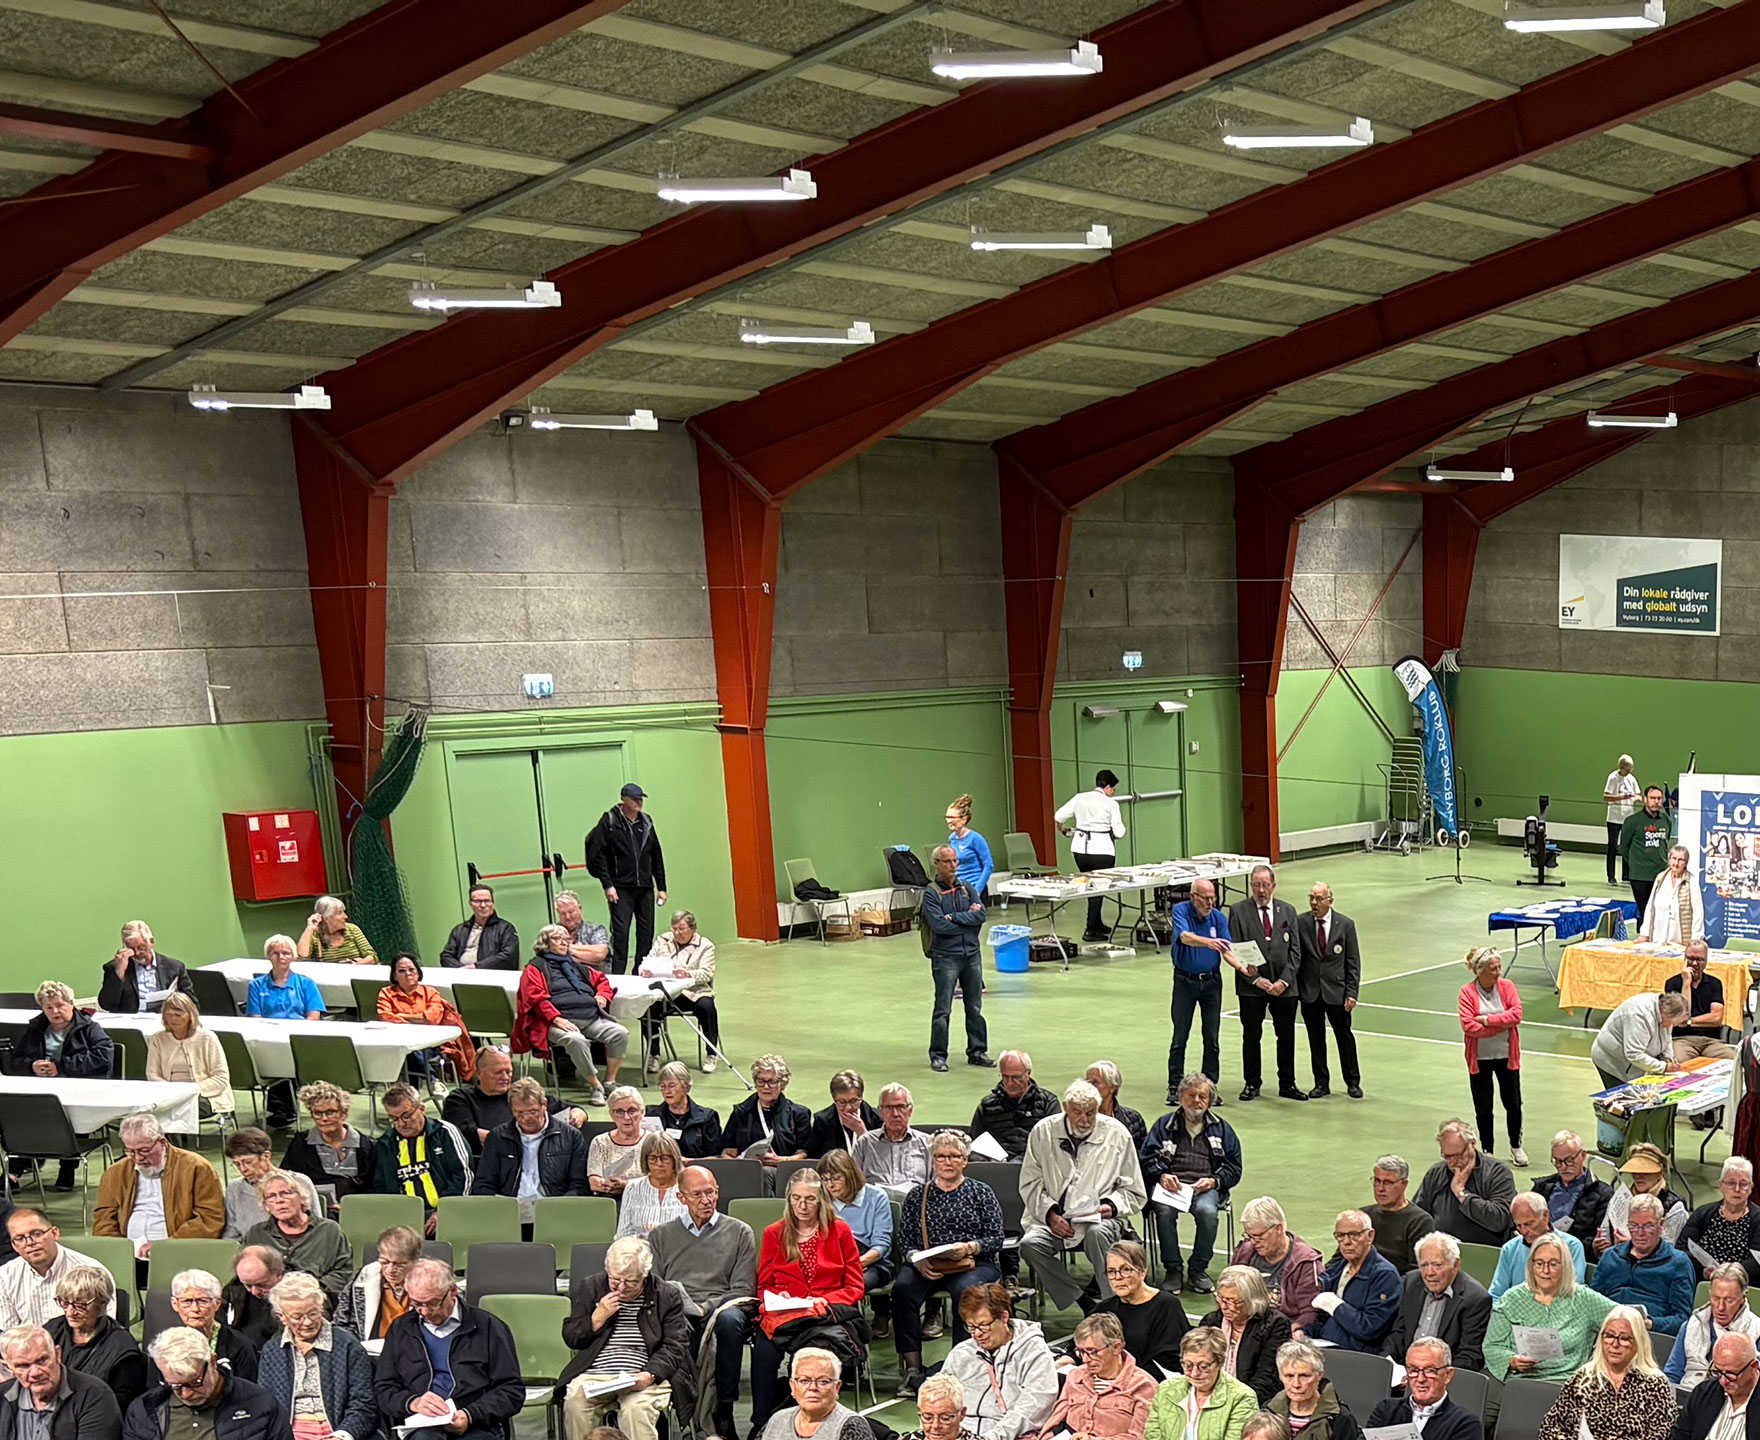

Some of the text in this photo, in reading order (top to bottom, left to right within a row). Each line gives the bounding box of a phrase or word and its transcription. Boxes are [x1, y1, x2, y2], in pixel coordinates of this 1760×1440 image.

[1623, 586, 1710, 602] Din lokale rådgiver
[1561, 606, 1576, 617] EY
[1623, 600, 1708, 616] med globalt udsyn
